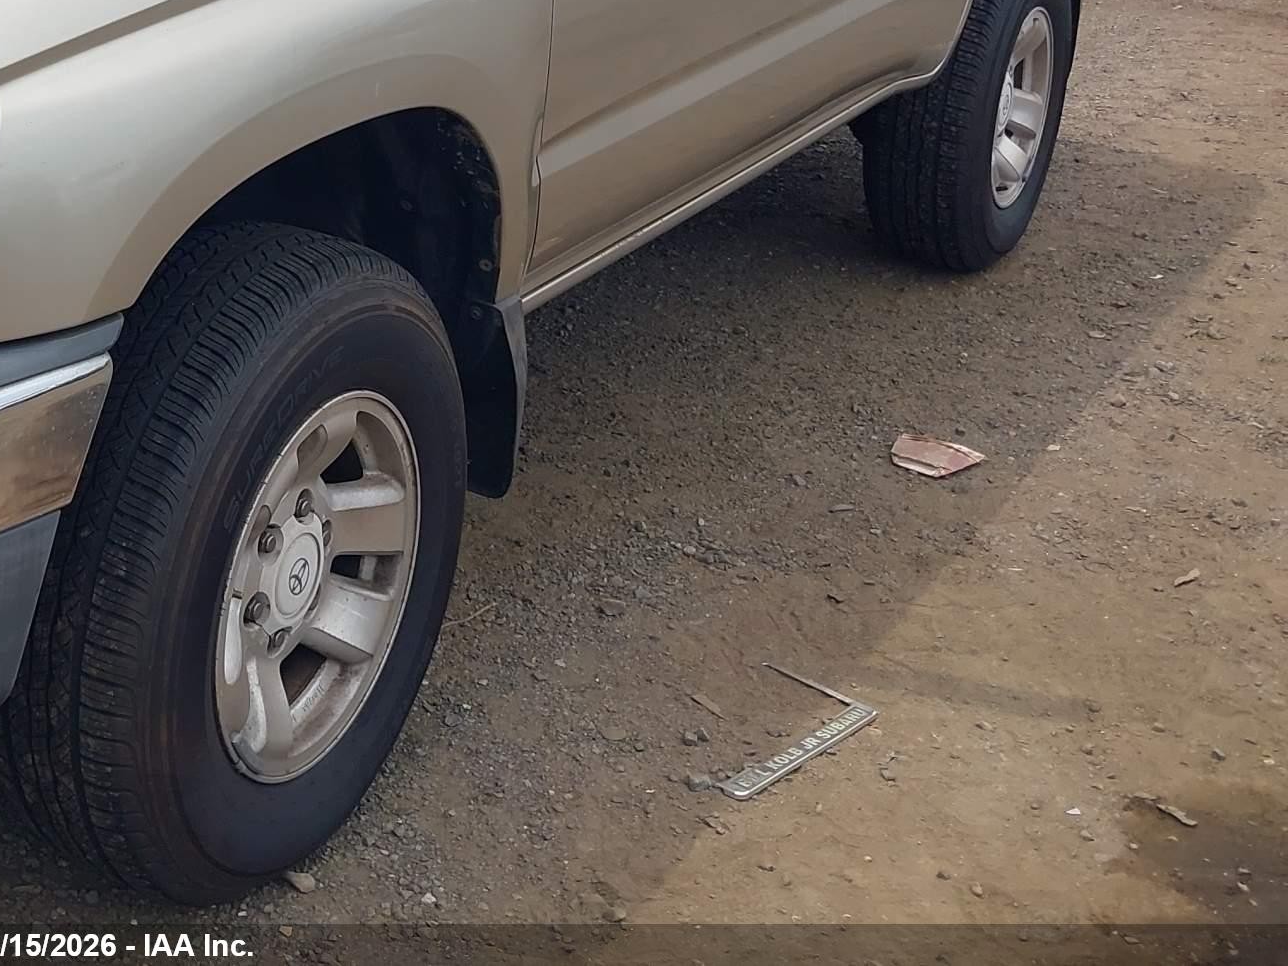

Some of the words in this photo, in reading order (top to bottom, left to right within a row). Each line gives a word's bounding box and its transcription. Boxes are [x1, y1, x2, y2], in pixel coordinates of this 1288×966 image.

[765, 747, 803, 771] KOLB
[800, 737, 823, 750] JR
[815, 706, 867, 739] SUBARU
